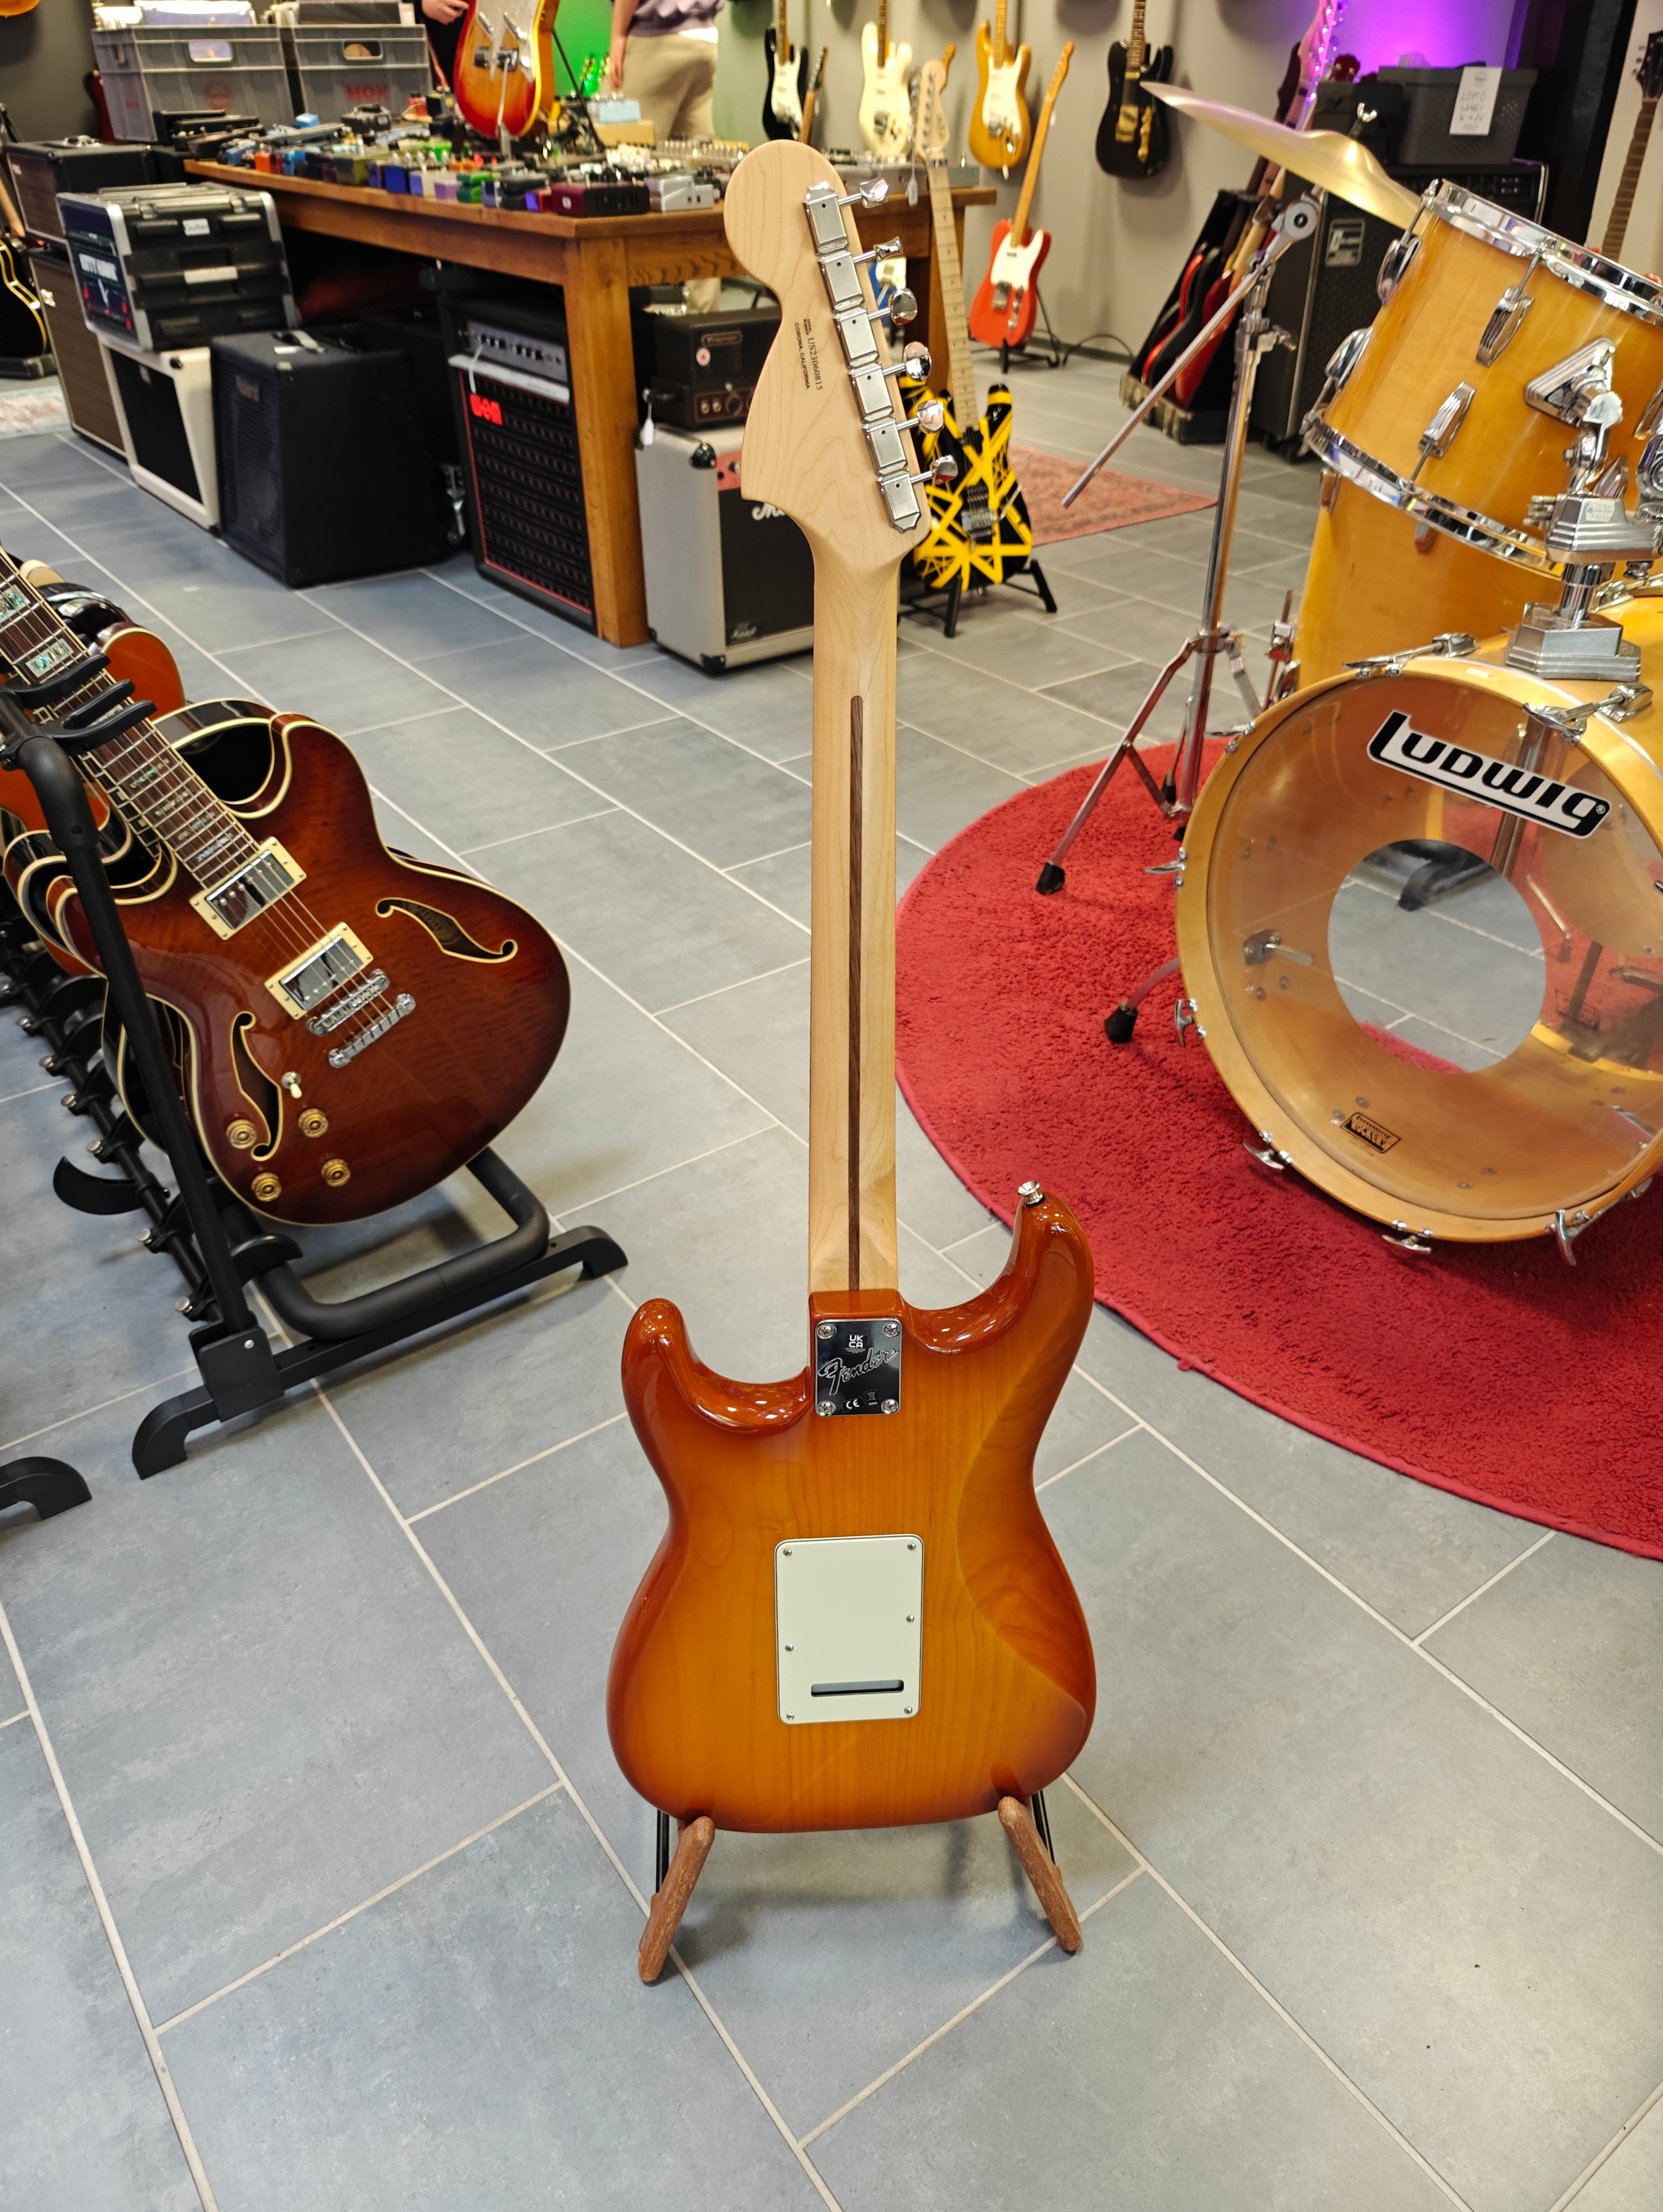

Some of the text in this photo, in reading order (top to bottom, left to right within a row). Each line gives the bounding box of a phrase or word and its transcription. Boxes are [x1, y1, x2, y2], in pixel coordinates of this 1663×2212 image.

[800, 352, 810, 389] CALIFORNIA
[808, 337, 823, 390] US23060815
[817, 1348, 900, 1396] Fender
